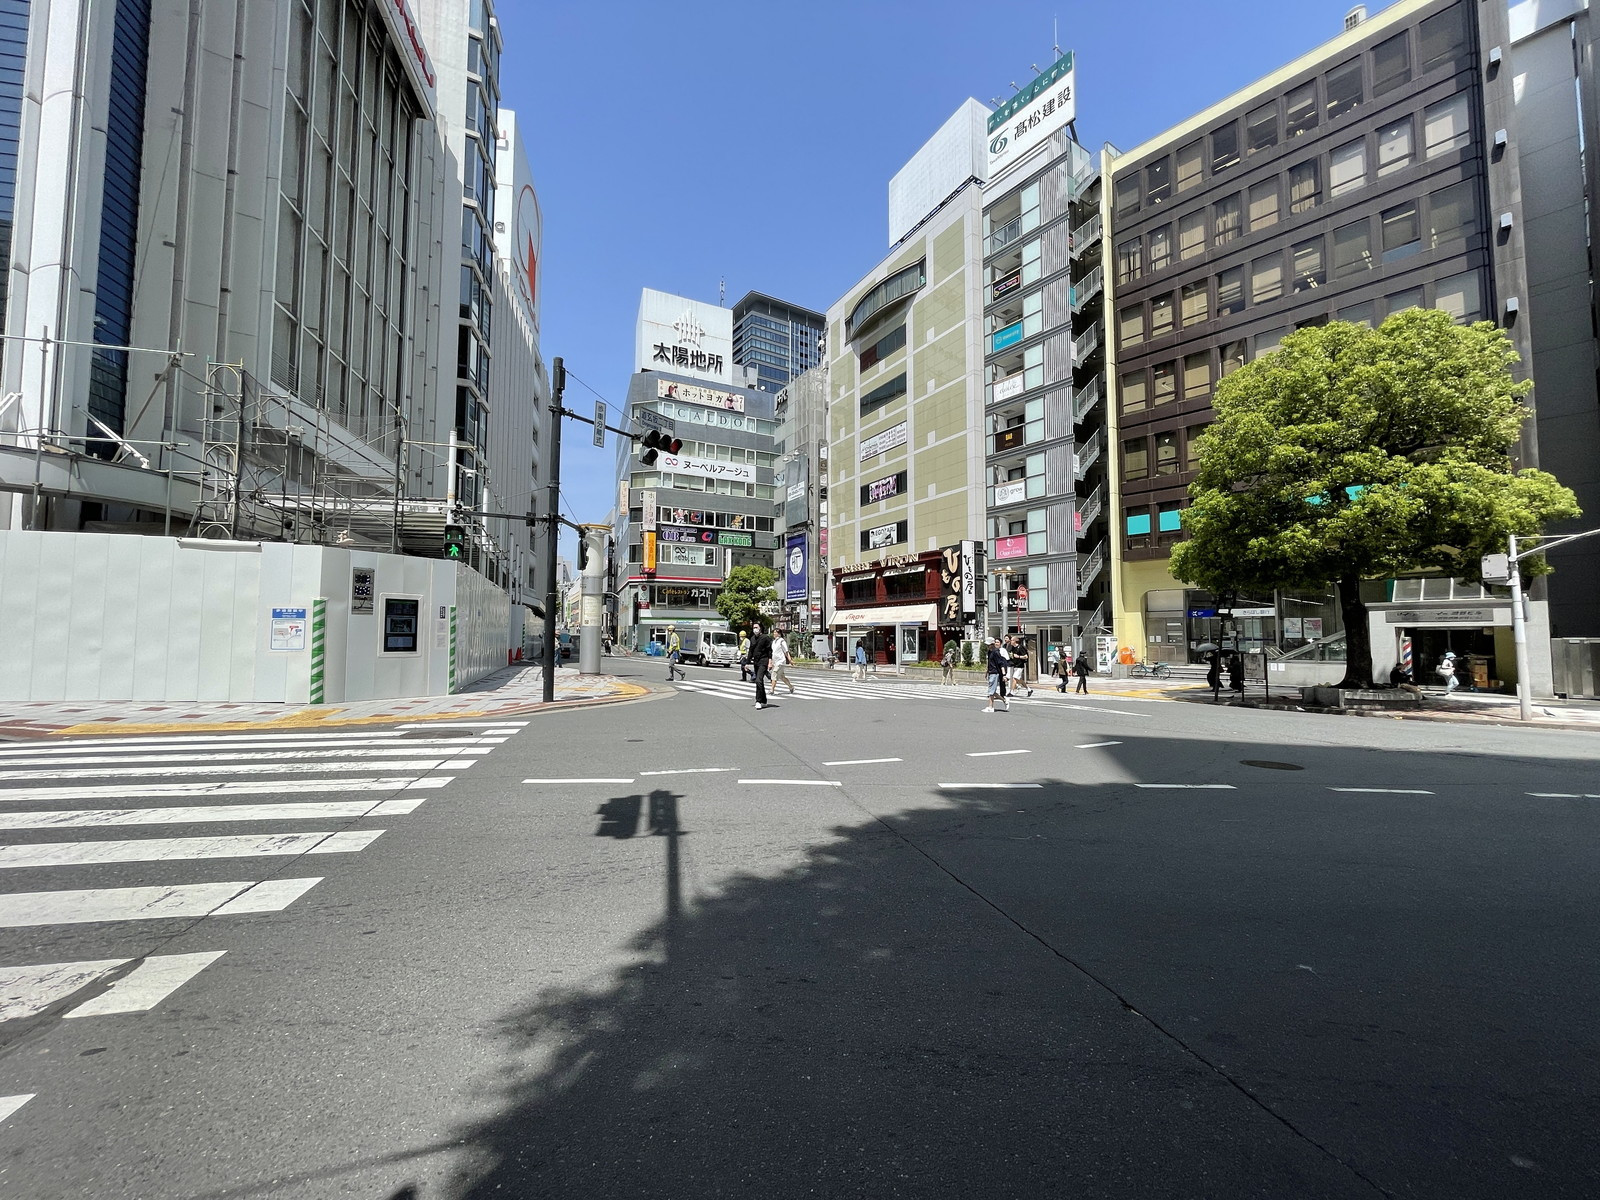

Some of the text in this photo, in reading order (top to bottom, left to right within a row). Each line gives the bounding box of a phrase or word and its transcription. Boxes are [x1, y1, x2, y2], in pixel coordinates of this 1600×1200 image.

[654, 342, 724, 374] 太陽地所
[682, 388, 724, 403] ホットヨガ
[677, 408, 743, 427] CALDO
[683, 460, 750, 478] ヌーベルアージュ
[691, 588, 713, 598] ガスト
[845, 613, 866, 621] VIRON
